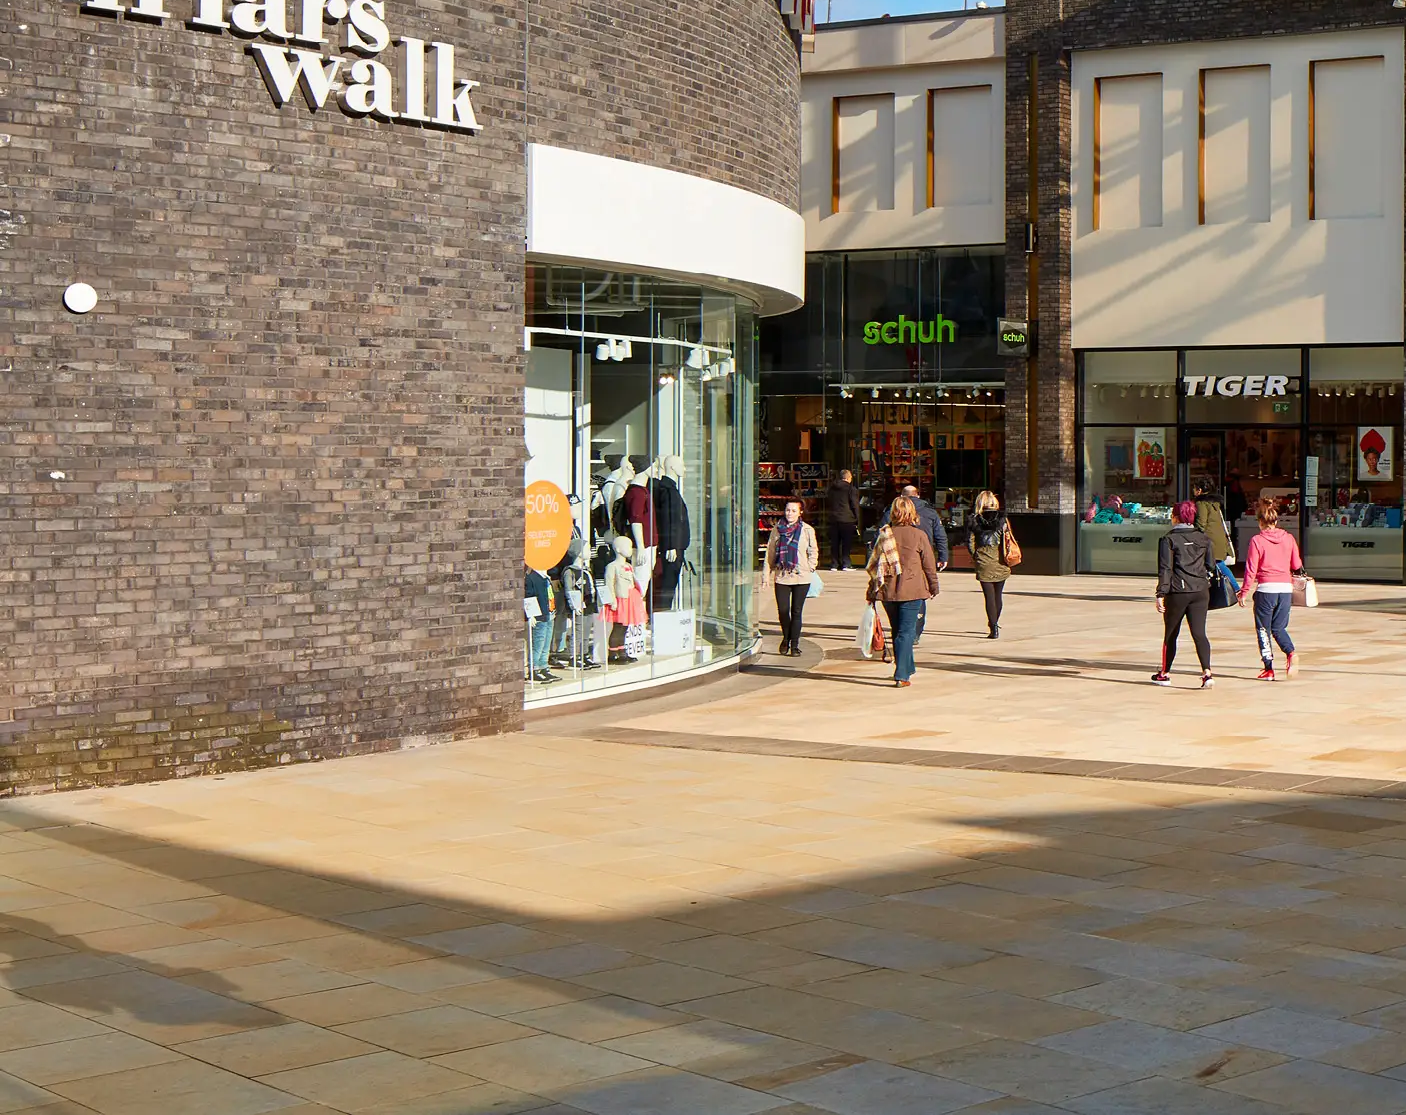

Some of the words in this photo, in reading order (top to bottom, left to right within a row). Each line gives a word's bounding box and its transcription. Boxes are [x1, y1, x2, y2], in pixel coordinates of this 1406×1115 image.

[250, 36, 483, 131] walk
[863, 314, 955, 344] schuh
[1002, 332, 1025, 343] schuh
[1183, 375, 1289, 397] TIGER
[526, 494, 559, 514] 50%
